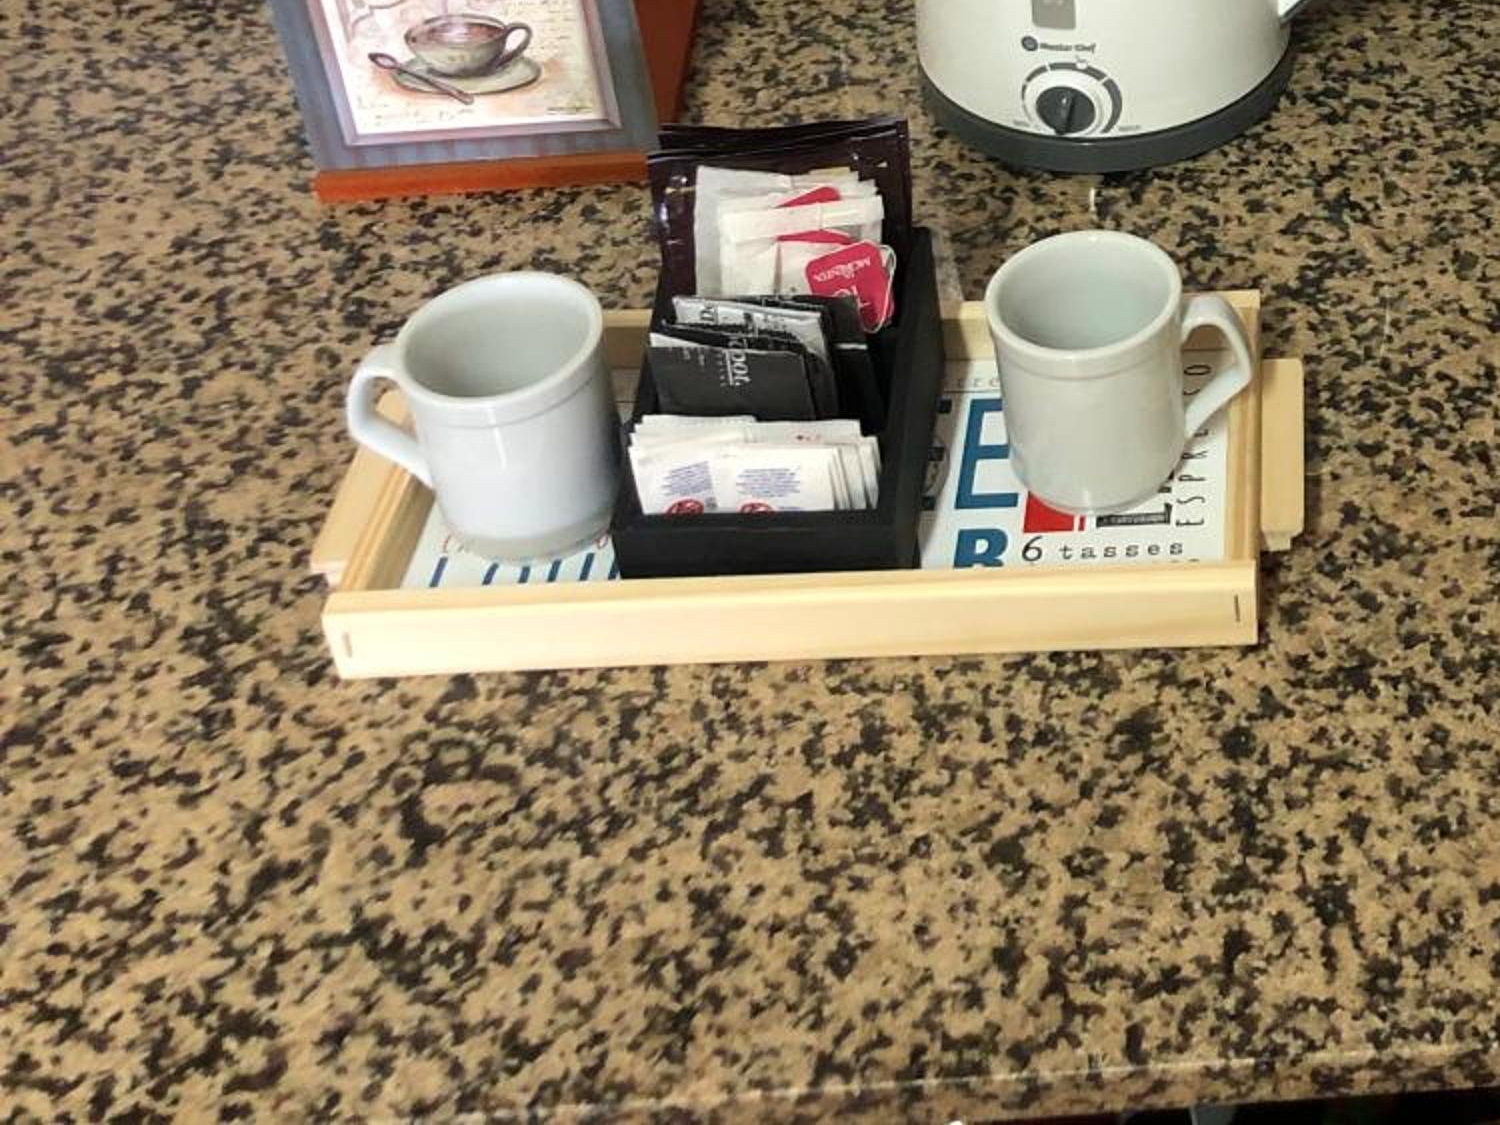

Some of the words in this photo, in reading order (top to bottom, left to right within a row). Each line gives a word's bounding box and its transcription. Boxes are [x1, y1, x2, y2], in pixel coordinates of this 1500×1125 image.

[1175, 363, 1212, 527] ESPRO
[1021, 535, 1044, 562] 6
[1058, 542, 1184, 560] tasses
